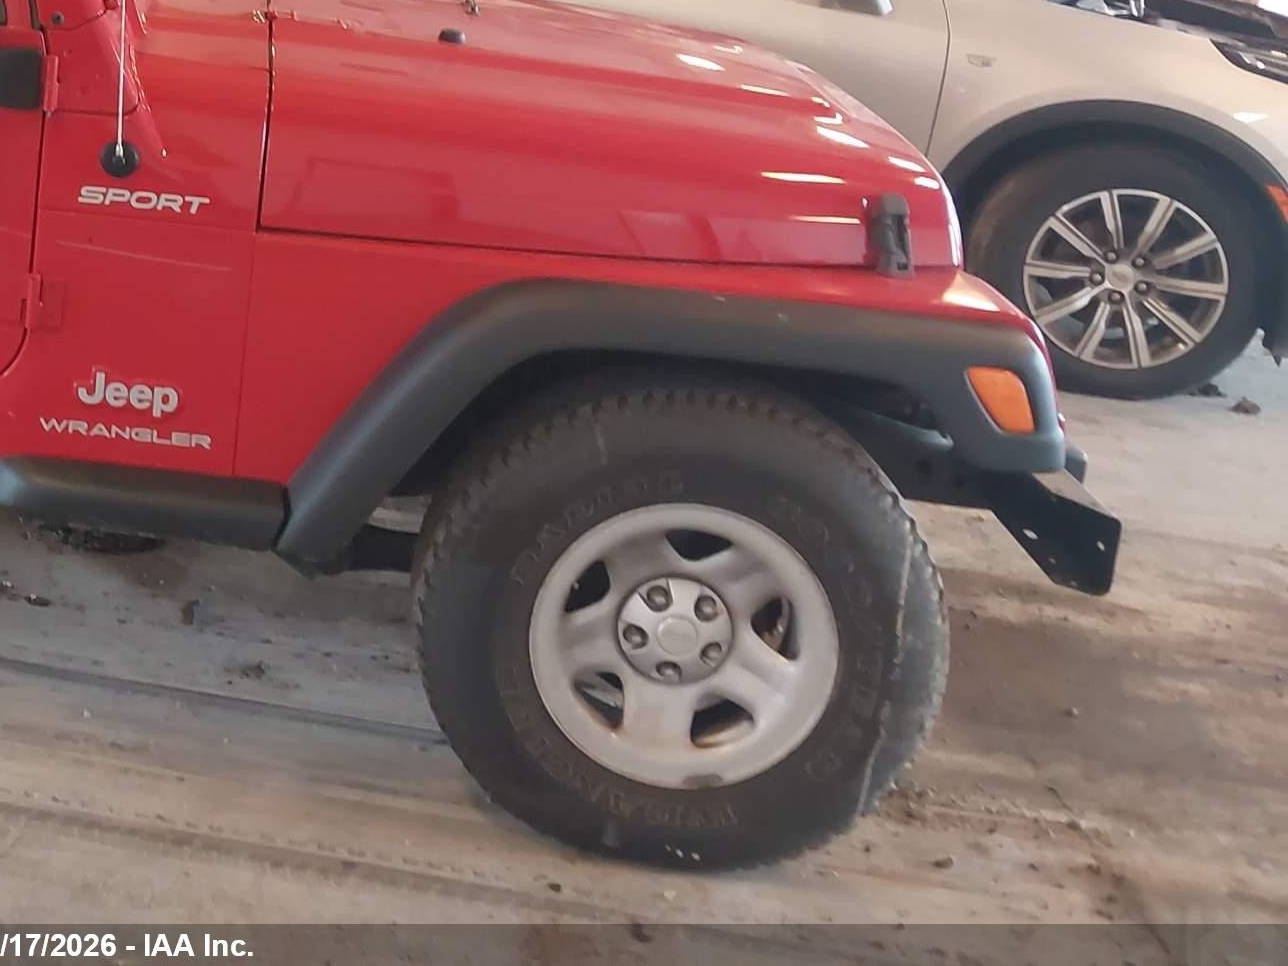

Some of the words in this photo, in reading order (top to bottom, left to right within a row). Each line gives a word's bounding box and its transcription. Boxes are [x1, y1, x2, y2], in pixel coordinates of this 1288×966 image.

[78, 186, 210, 214] SPORT
[77, 371, 179, 418] Jeep
[39, 417, 211, 449] WRANGLER
